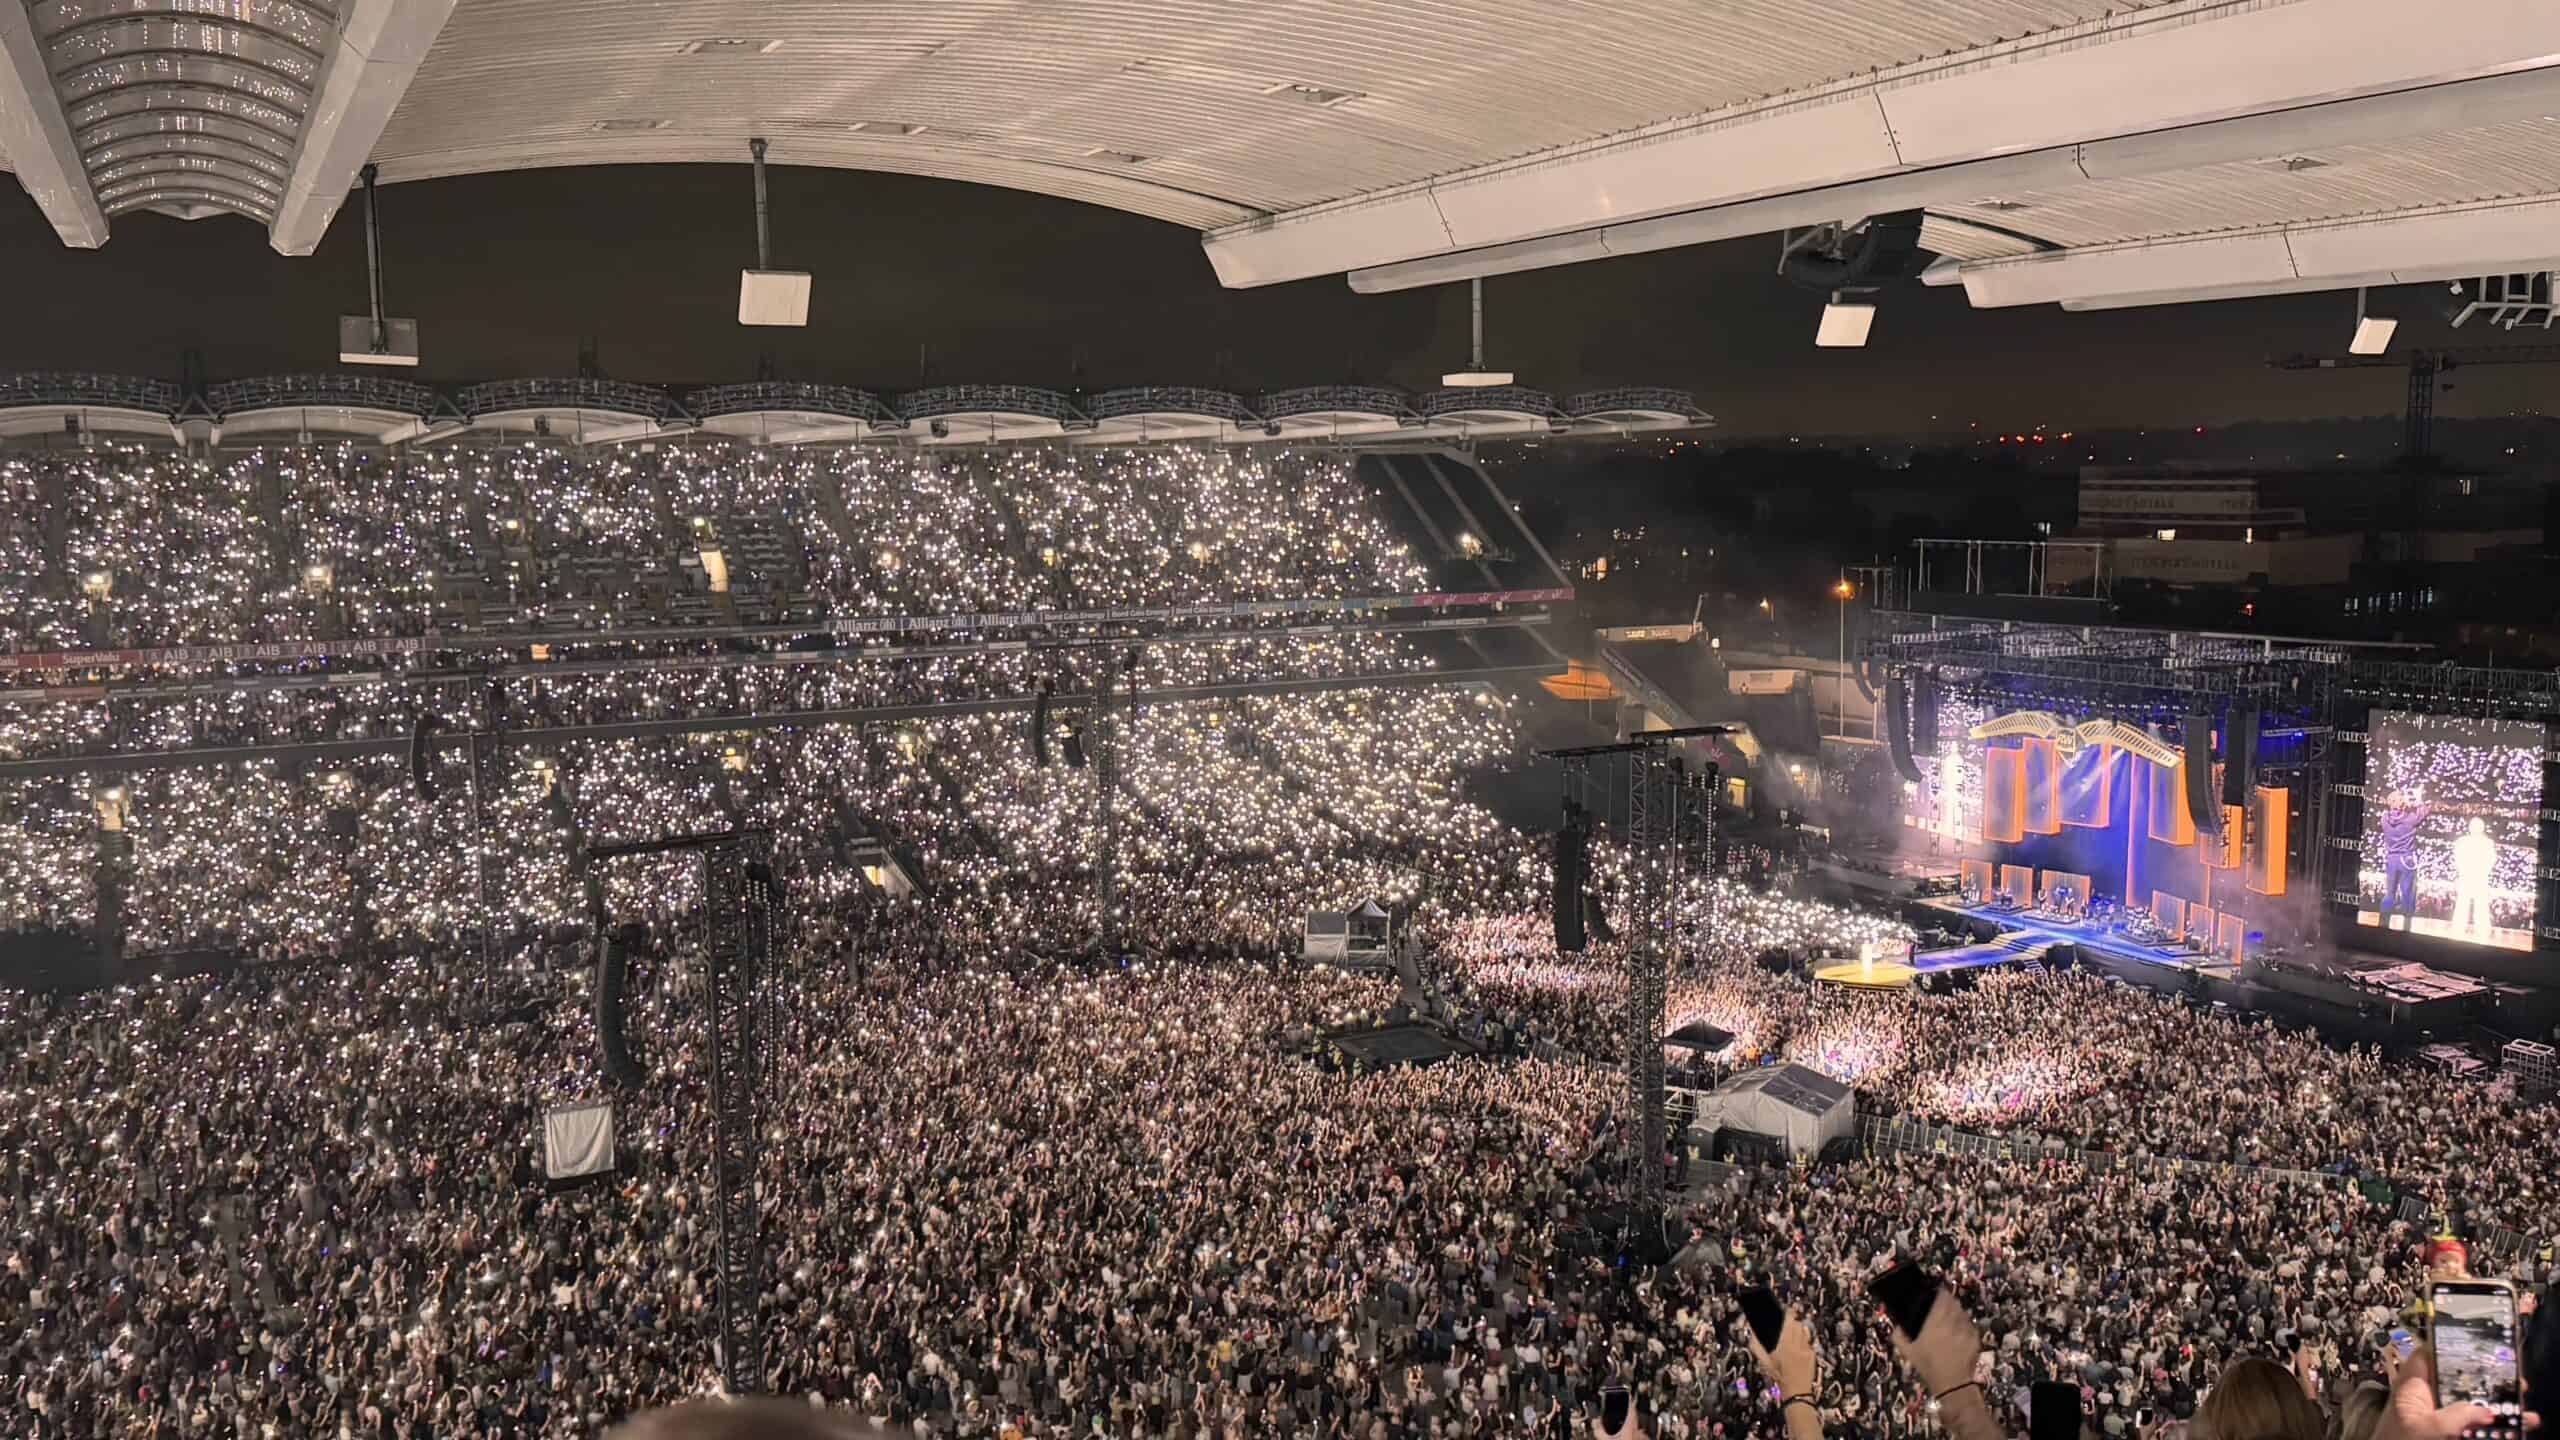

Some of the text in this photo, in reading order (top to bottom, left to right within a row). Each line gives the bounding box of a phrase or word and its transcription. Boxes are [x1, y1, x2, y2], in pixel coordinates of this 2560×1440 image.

[910, 616, 950, 629] Allianz
[980, 614, 1019, 625] Allianz
[835, 620, 878, 632] Allianz
[256, 644, 280, 656] AIB
[303, 643, 327, 656] AIB
[353, 641, 377, 652] AIB
[394, 639, 418, 649] AIB
[164, 647, 189, 661] AIB
[207, 647, 234, 658] AIB
